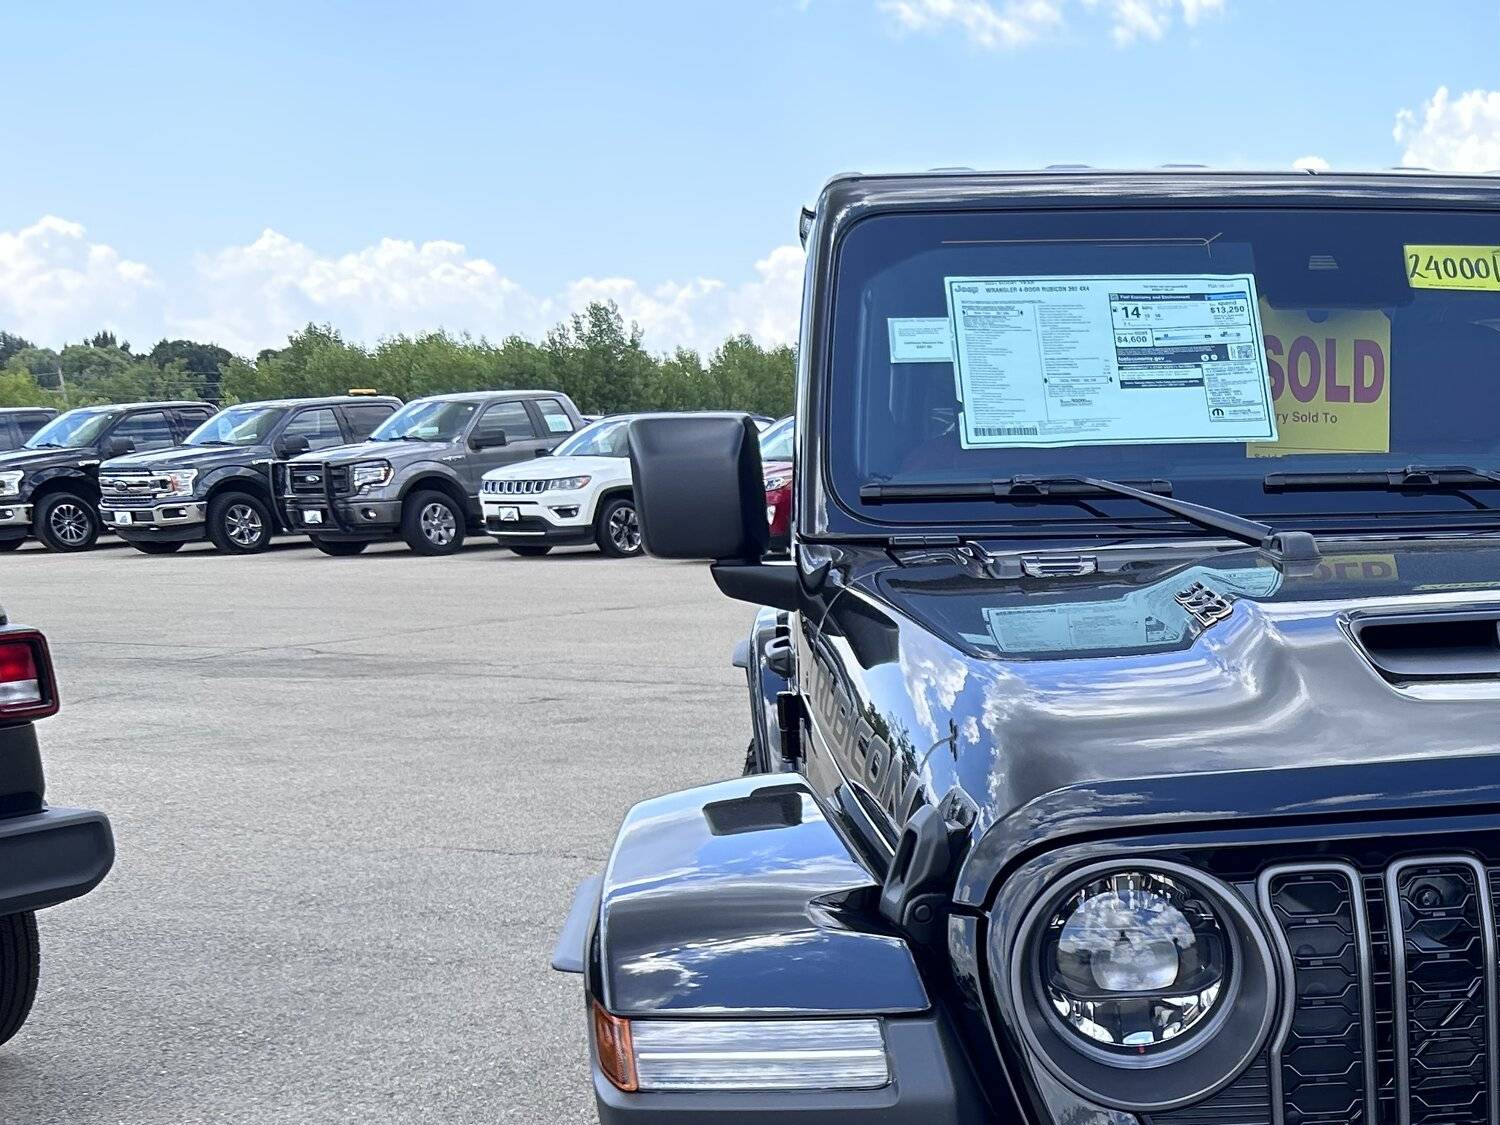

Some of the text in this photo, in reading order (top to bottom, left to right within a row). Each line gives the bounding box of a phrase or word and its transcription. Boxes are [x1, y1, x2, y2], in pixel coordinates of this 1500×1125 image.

[1121, 306, 1141, 319] 14
[1210, 306, 1245, 314] $13,250
[1116, 335, 1148, 344] $4,600
[1263, 334, 1385, 404] SOLD
[1292, 411, 1319, 424] Sold
[1323, 412, 1338, 424] To
[815, 657, 920, 828] RUBICON
